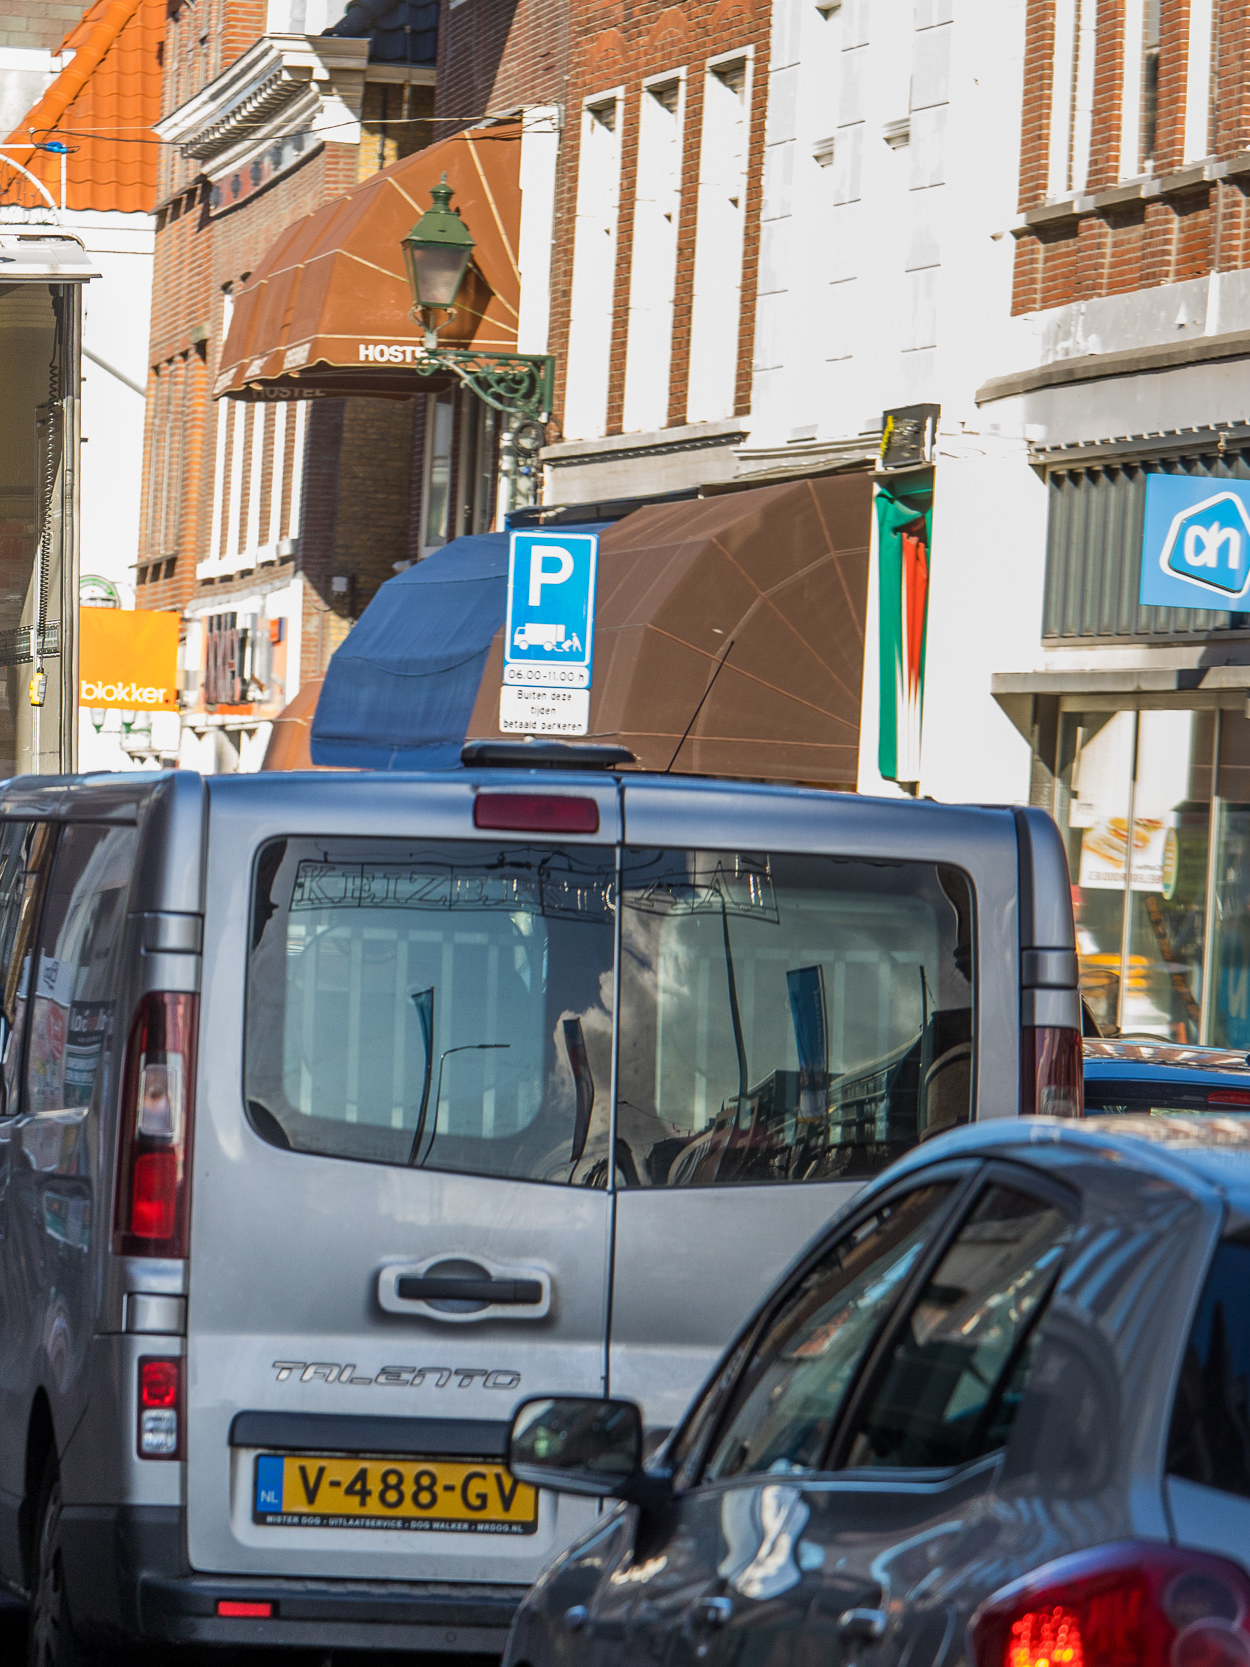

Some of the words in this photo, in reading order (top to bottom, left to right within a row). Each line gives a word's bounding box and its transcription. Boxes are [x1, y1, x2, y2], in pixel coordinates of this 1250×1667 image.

[359, 344, 440, 363] HOSTE
[528, 545, 574, 606] P
[517, 689, 547, 701] Buiten
[551, 691, 572, 701] deze
[531, 706, 556, 717] tijden
[503, 719, 537, 729] betaald
[541, 720, 582, 732] parkeren
[271, 1360, 522, 1390] TALENTO
[260, 1489, 279, 1503] NL
[298, 1464, 520, 1513] V-488-GV
[266, 1515, 300, 1525] MISTER
[411, 1520, 430, 1531] DOG
[433, 1521, 470, 1532] WALKER
